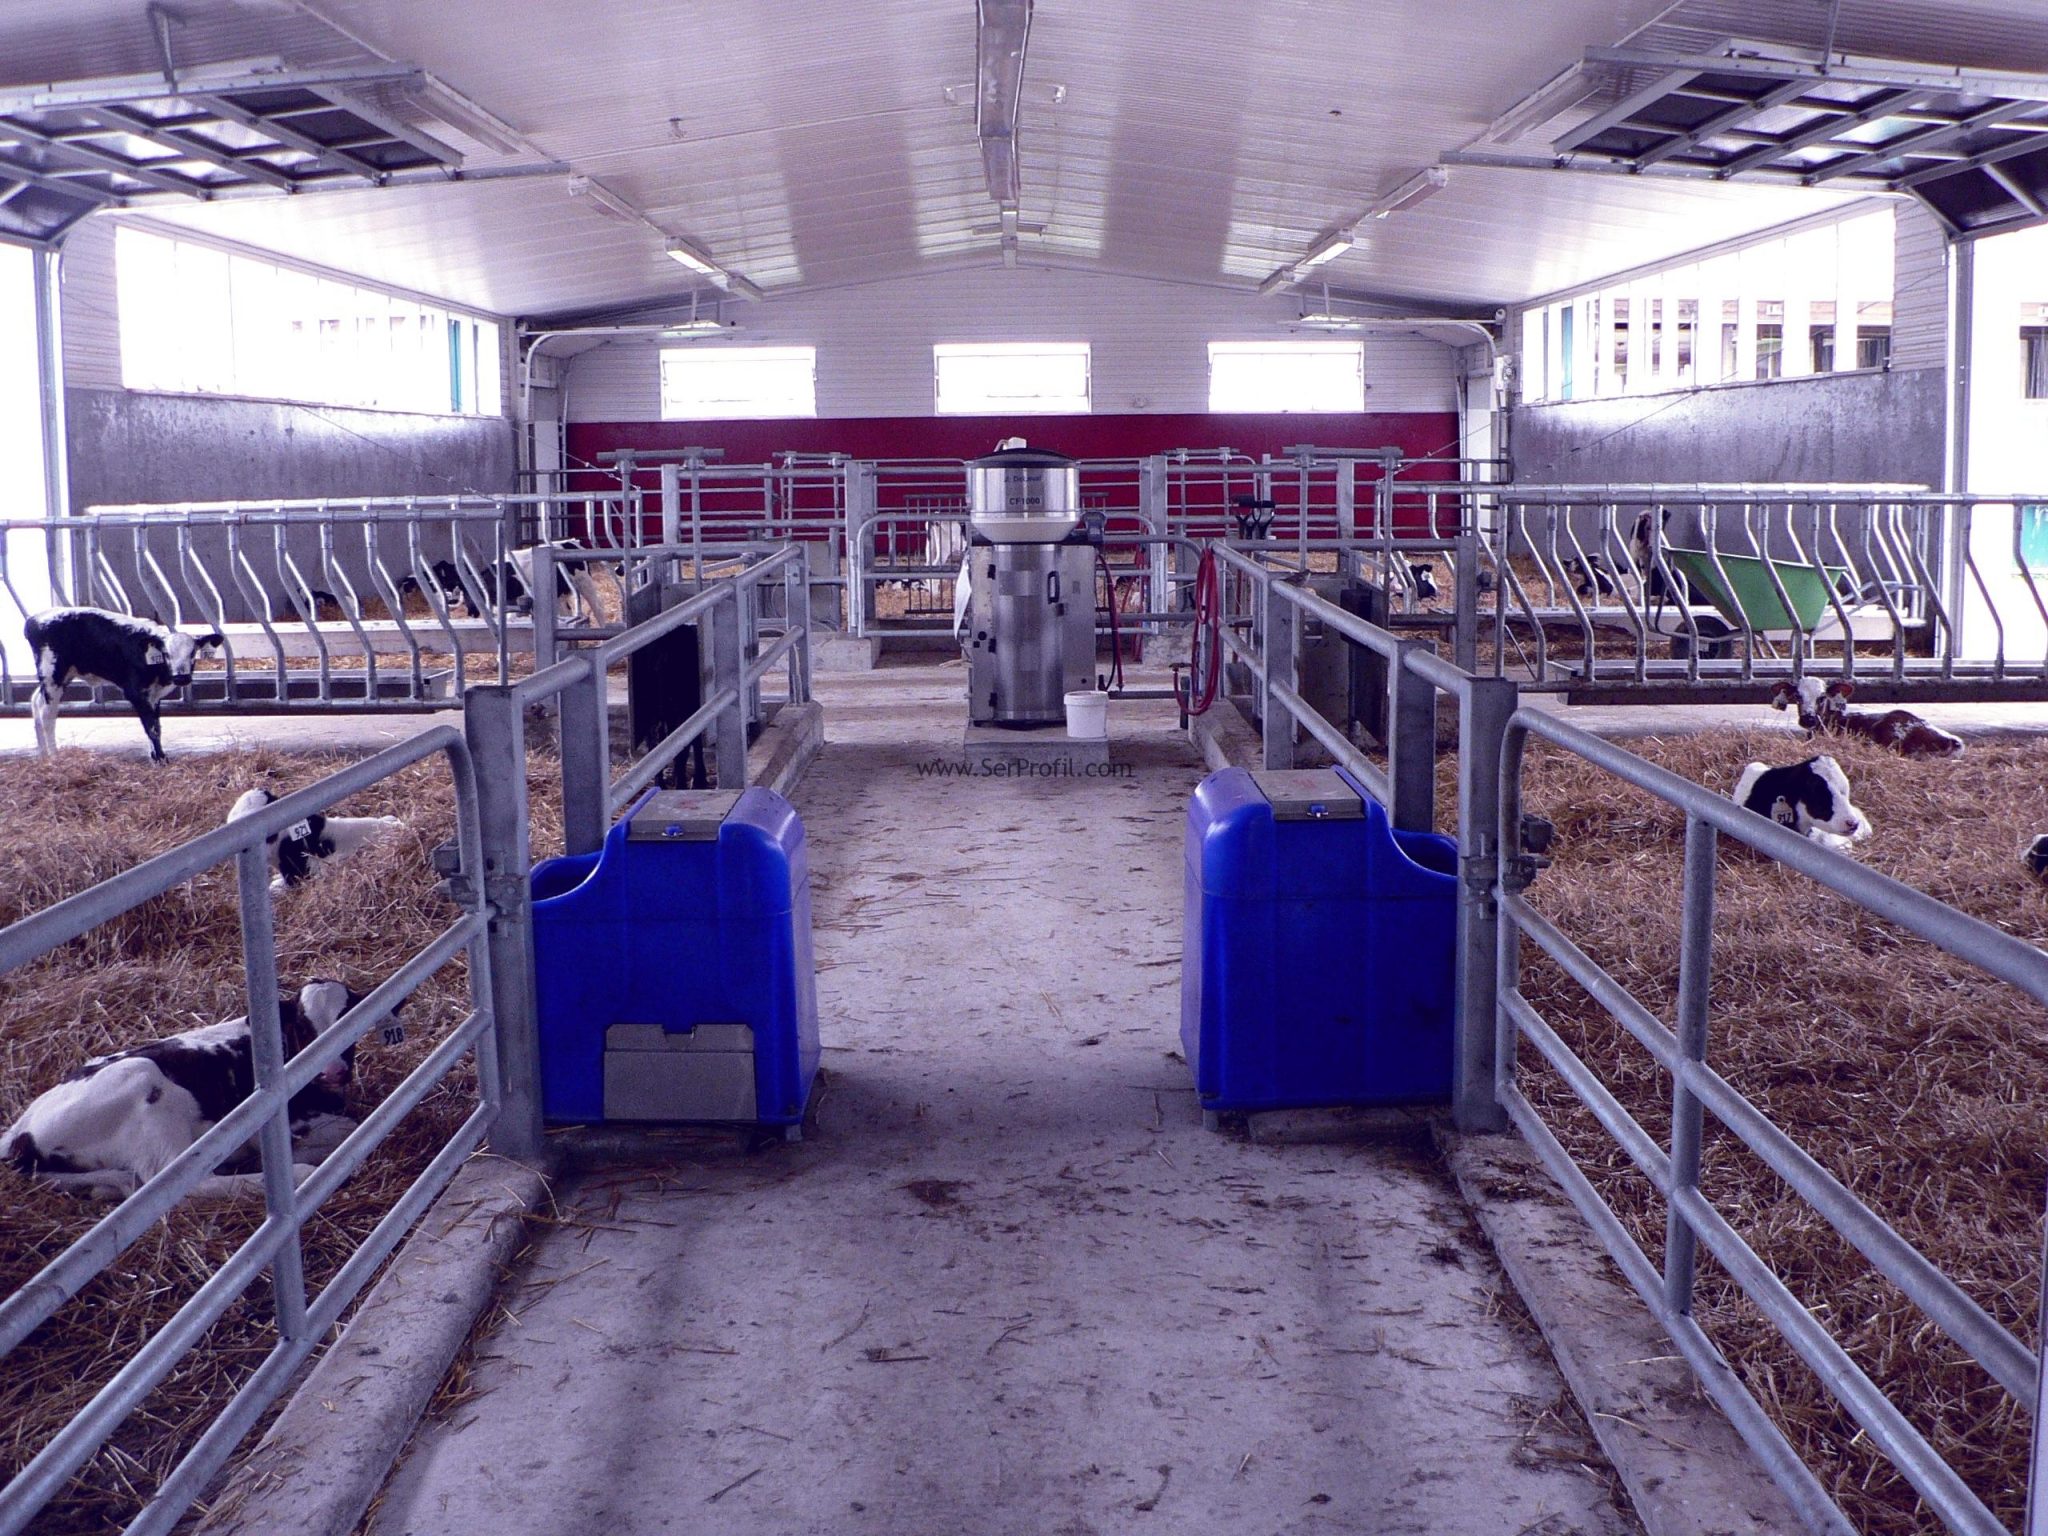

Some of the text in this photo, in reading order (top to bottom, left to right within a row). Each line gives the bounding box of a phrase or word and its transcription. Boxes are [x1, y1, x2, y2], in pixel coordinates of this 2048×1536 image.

[1009, 497, 1041, 505] CF1000
[1777, 812, 1791, 823] 917
[384, 1027, 404, 1045] 918
